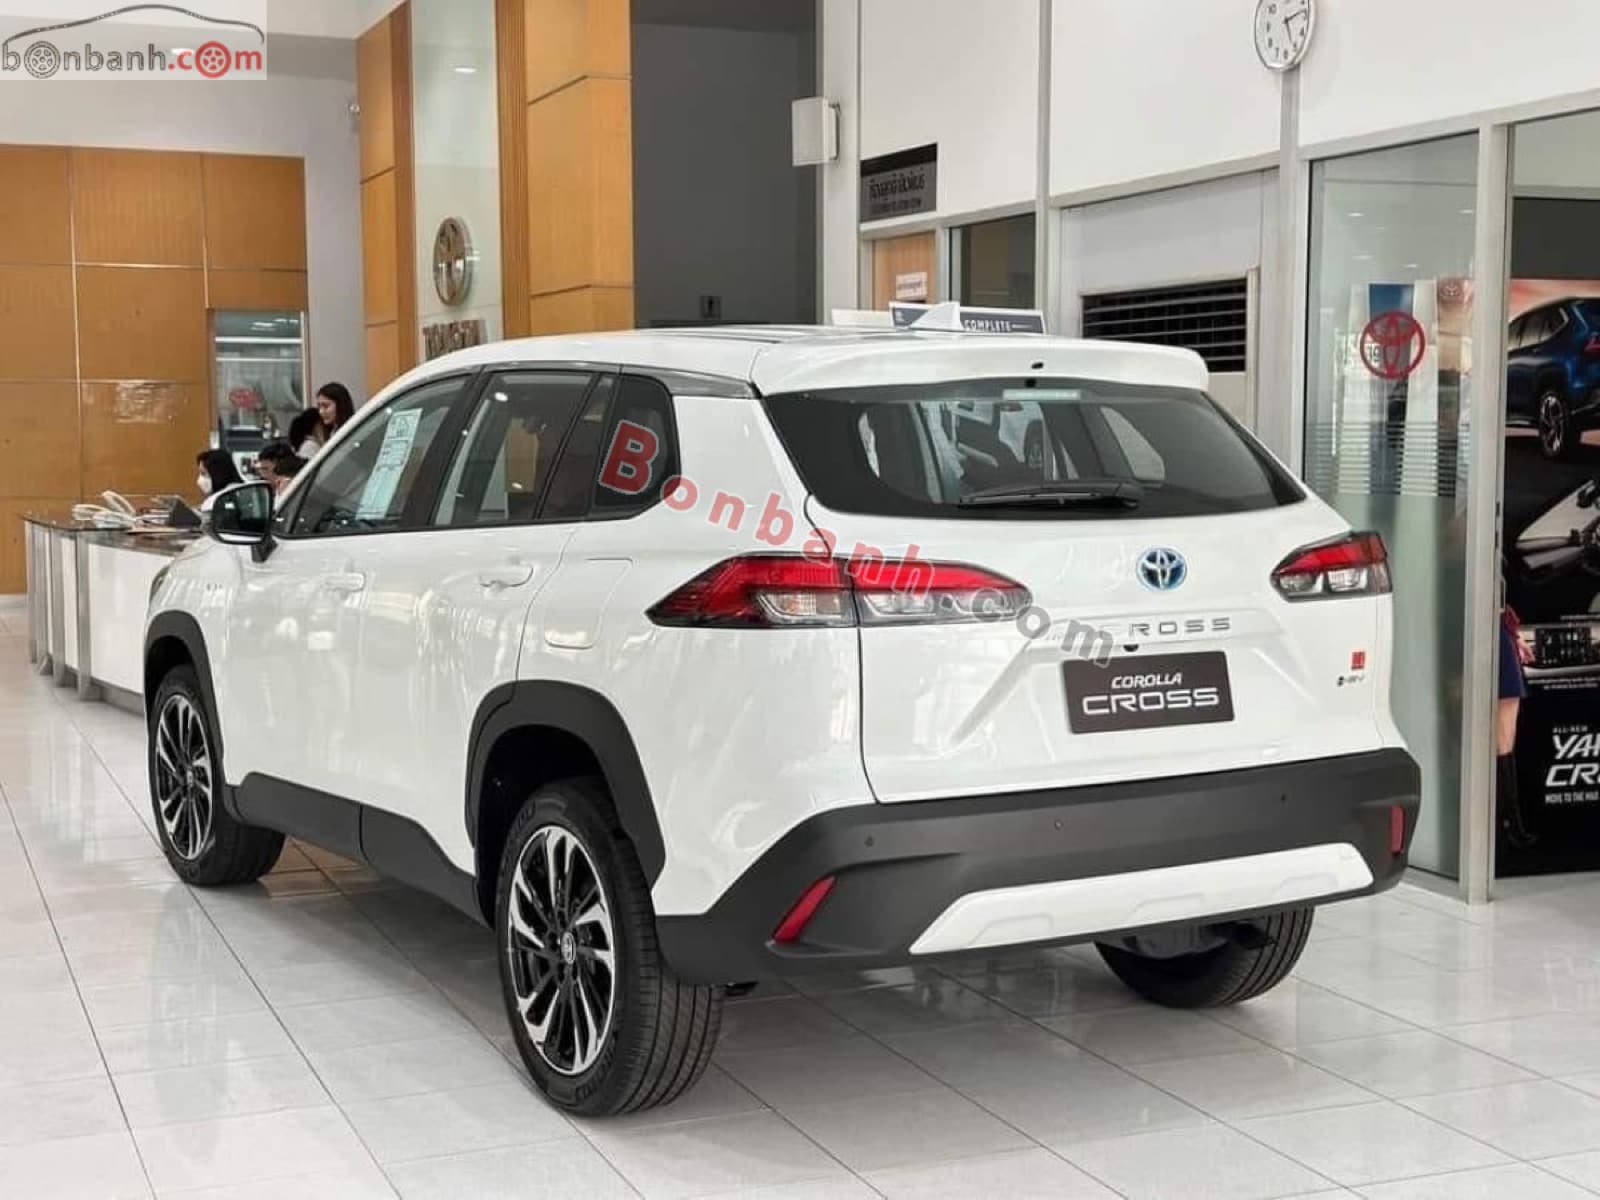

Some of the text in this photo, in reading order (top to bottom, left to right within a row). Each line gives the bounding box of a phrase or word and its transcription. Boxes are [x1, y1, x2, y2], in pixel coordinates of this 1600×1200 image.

[1111, 672, 1182, 690] COROLLA
[1082, 687, 1219, 715] CROSS
[1545, 763, 1600, 787] CR
